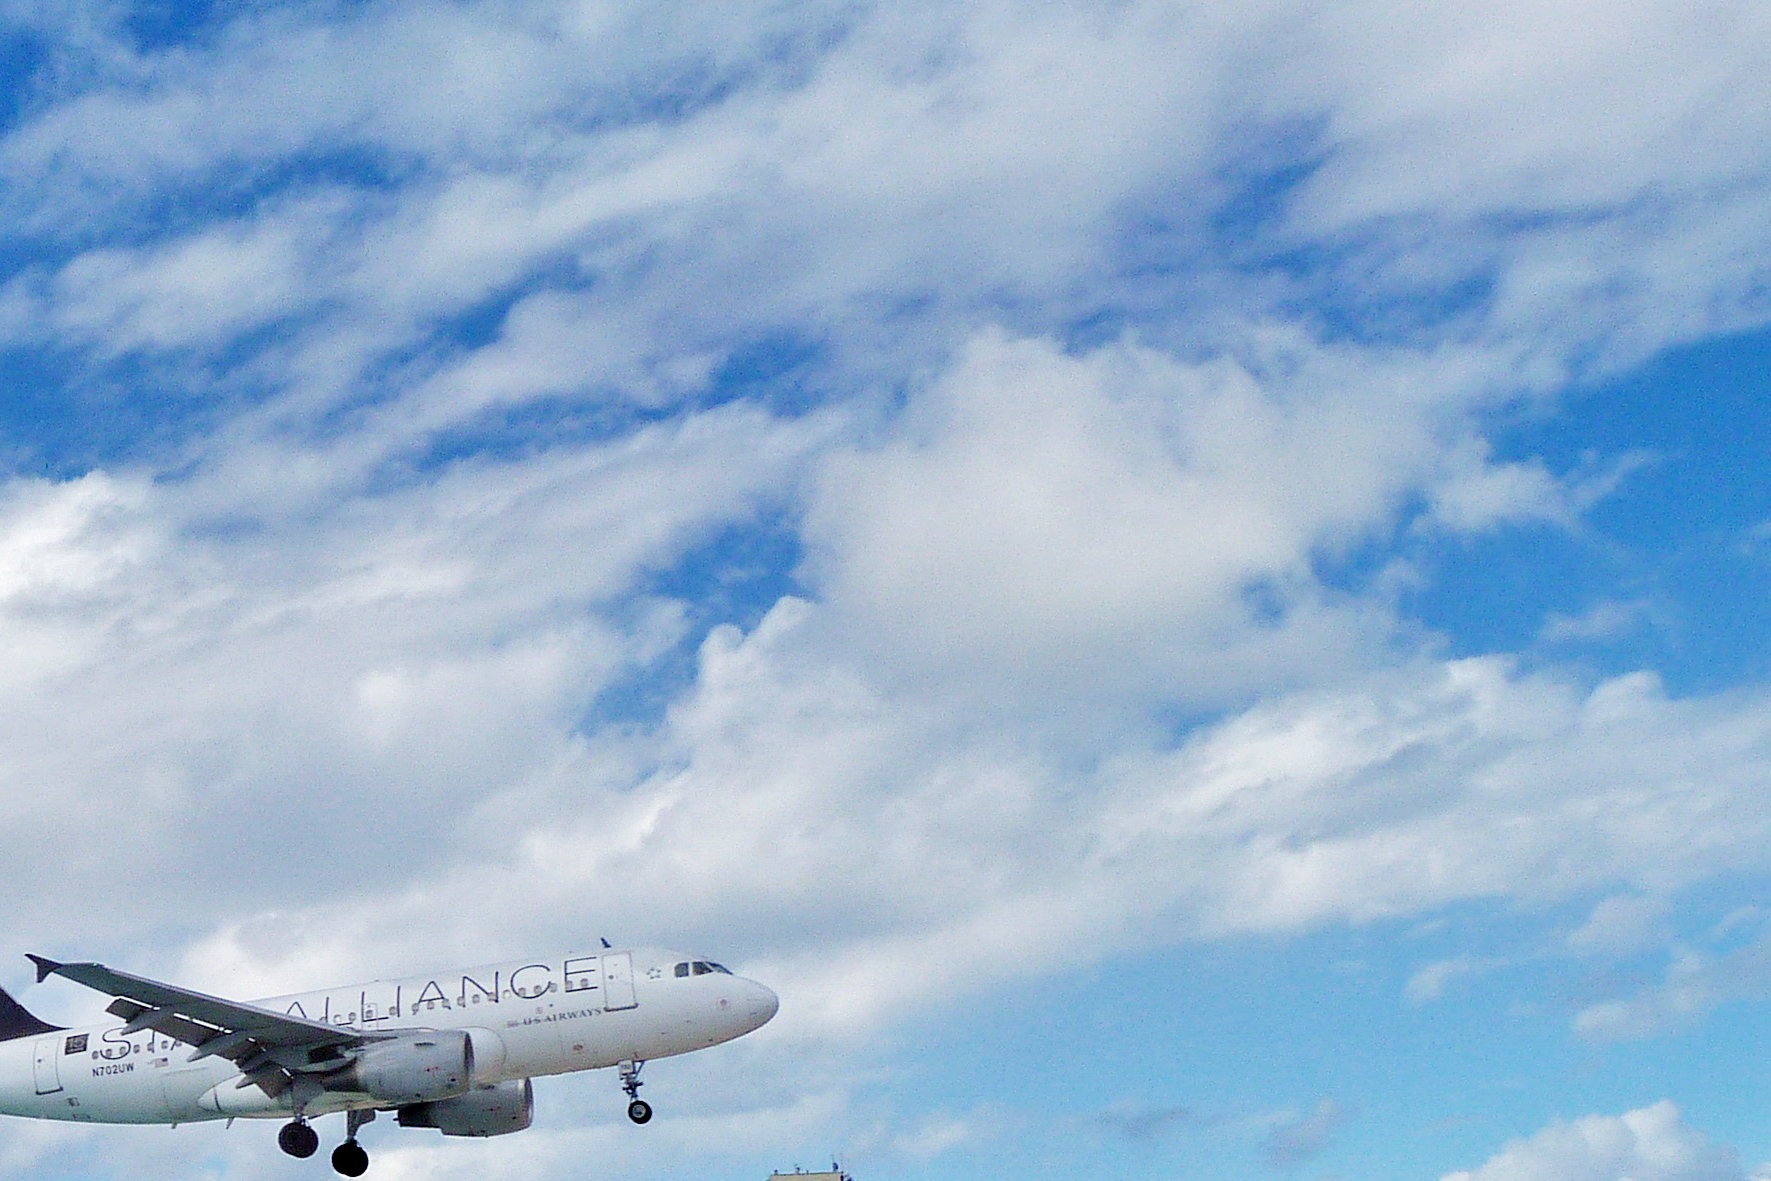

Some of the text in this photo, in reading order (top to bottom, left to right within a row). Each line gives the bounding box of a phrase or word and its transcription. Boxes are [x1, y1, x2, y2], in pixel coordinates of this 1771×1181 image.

[285, 956, 598, 1026] ALLIANCE
[523, 1007, 601, 1026] US AIRWAYS
[92, 1062, 135, 1078] N702UW
